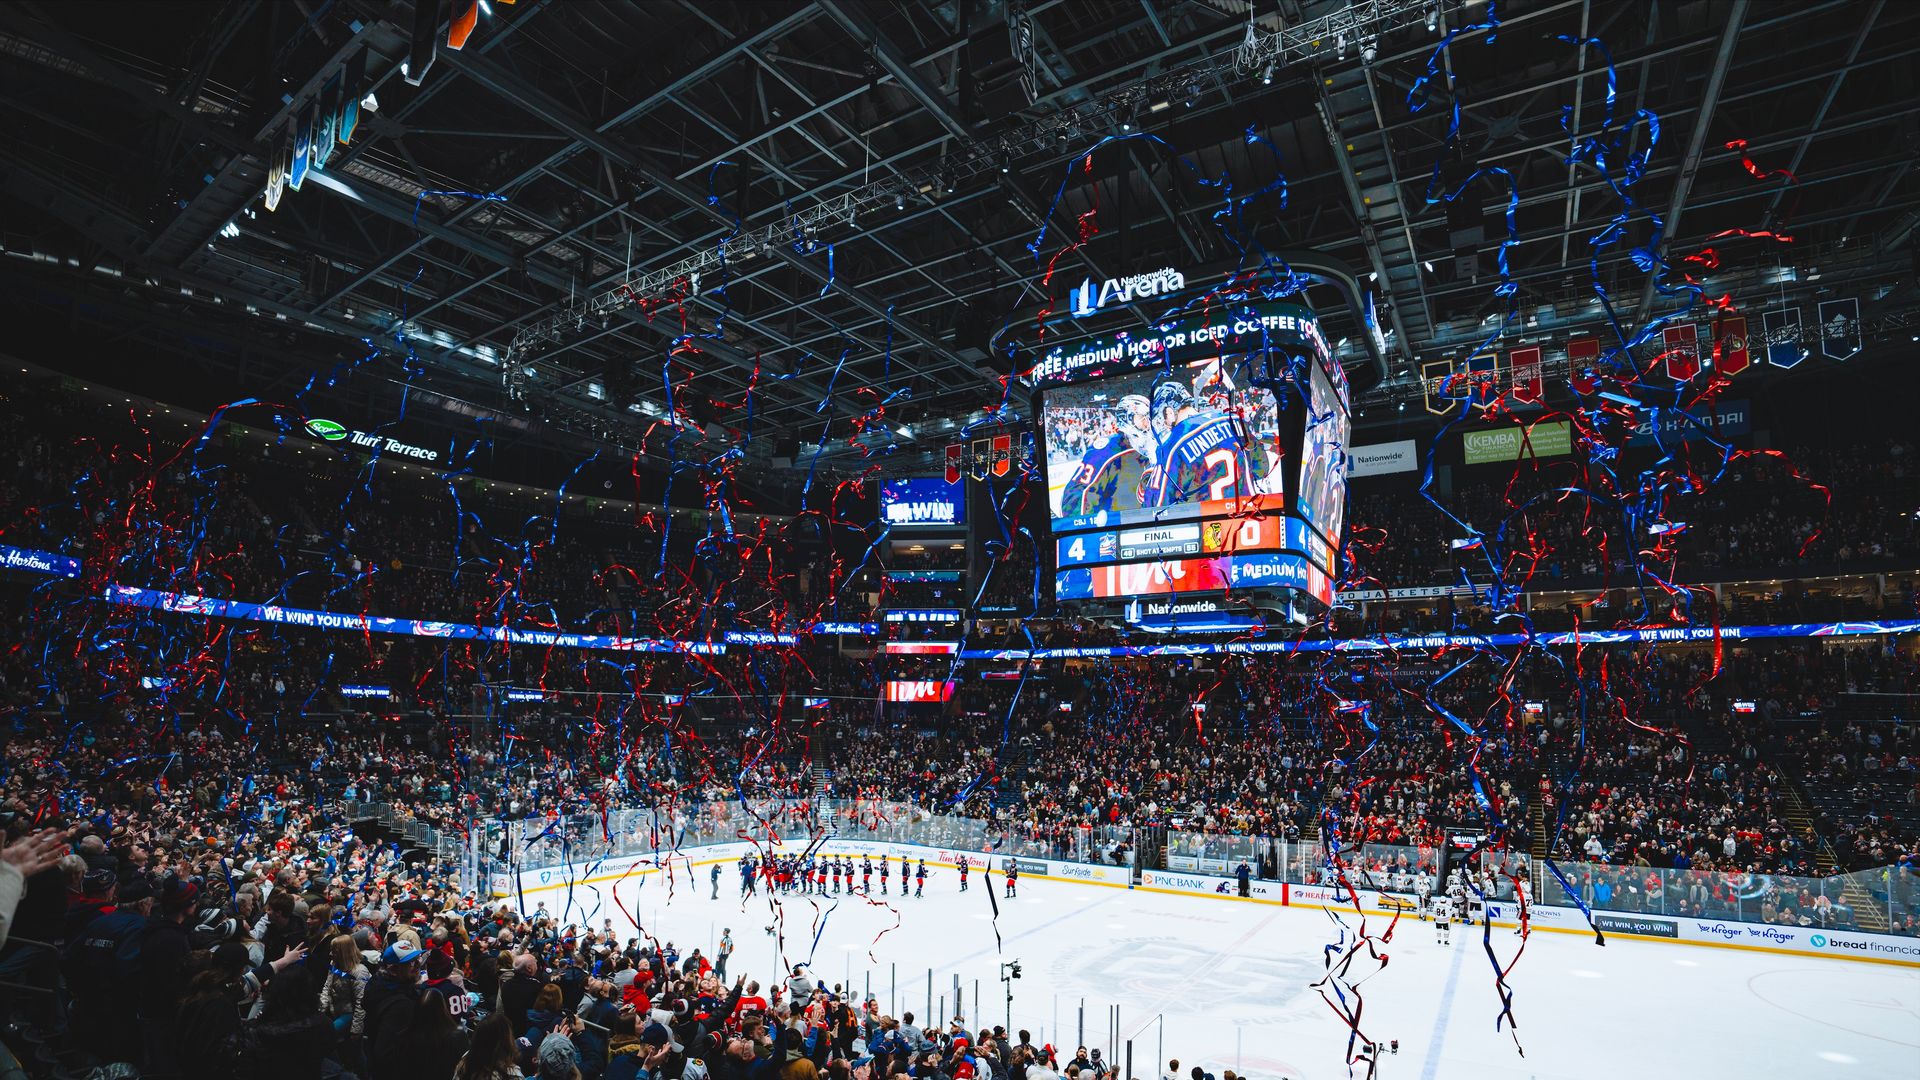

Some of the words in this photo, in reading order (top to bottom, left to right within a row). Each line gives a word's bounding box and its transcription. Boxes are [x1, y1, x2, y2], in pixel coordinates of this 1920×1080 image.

[1121, 267, 1175, 287] Nationwide
[1096, 271, 1185, 308] Arena
[1032, 357, 1062, 382] FREE
[1066, 342, 1123, 369] MEDIUM
[1127, 339, 1159, 356] HOT
[1164, 333, 1187, 349] OR
[1191, 325, 1228, 344] ICED
[1234, 316, 1295, 334] COFFEE
[1474, 433, 1516, 447] KEMBA
[384, 438, 437, 461] Terrace
[1358, 452, 1404, 464] Nationwide
[1144, 531, 1174, 542] FINAL
[1240, 521, 1261, 547] 0
[1067, 537, 1086, 561] 4
[1136, 548, 1151, 556] SHOT
[8, 550, 51, 570] Hortons
[1243, 564, 1295, 579] MEDIUM
[1363, 586, 1441, 599] JACKETS
[1148, 600, 1216, 615] Nationwide
[264, 609, 283, 621] WE
[317, 615, 341, 627] YOU
[824, 623, 836, 632] Tim
[535, 635, 553, 644] YOU
[1408, 637, 1422, 646] WE
[1424, 636, 1449, 646] WIN,
[1640, 630, 1657, 640] WE
[1660, 629, 1688, 639] WIN,
[1691, 629, 1713, 638] YOU
[1227, 643, 1247, 652] WIN,
[1250, 642, 1265, 650] YOU
[939, 851, 953, 862] Tim
[604, 863, 631, 872] Nationw
[1062, 865, 1091, 876] Surfside
[1155, 875, 1176, 887] PNC
[1177, 877, 1205, 889] BANK
[1436, 908, 1446, 916] 84
[1711, 923, 1742, 939] Kroger
[1762, 928, 1795, 944] Kroger
[1830, 938, 1867, 950] bread
